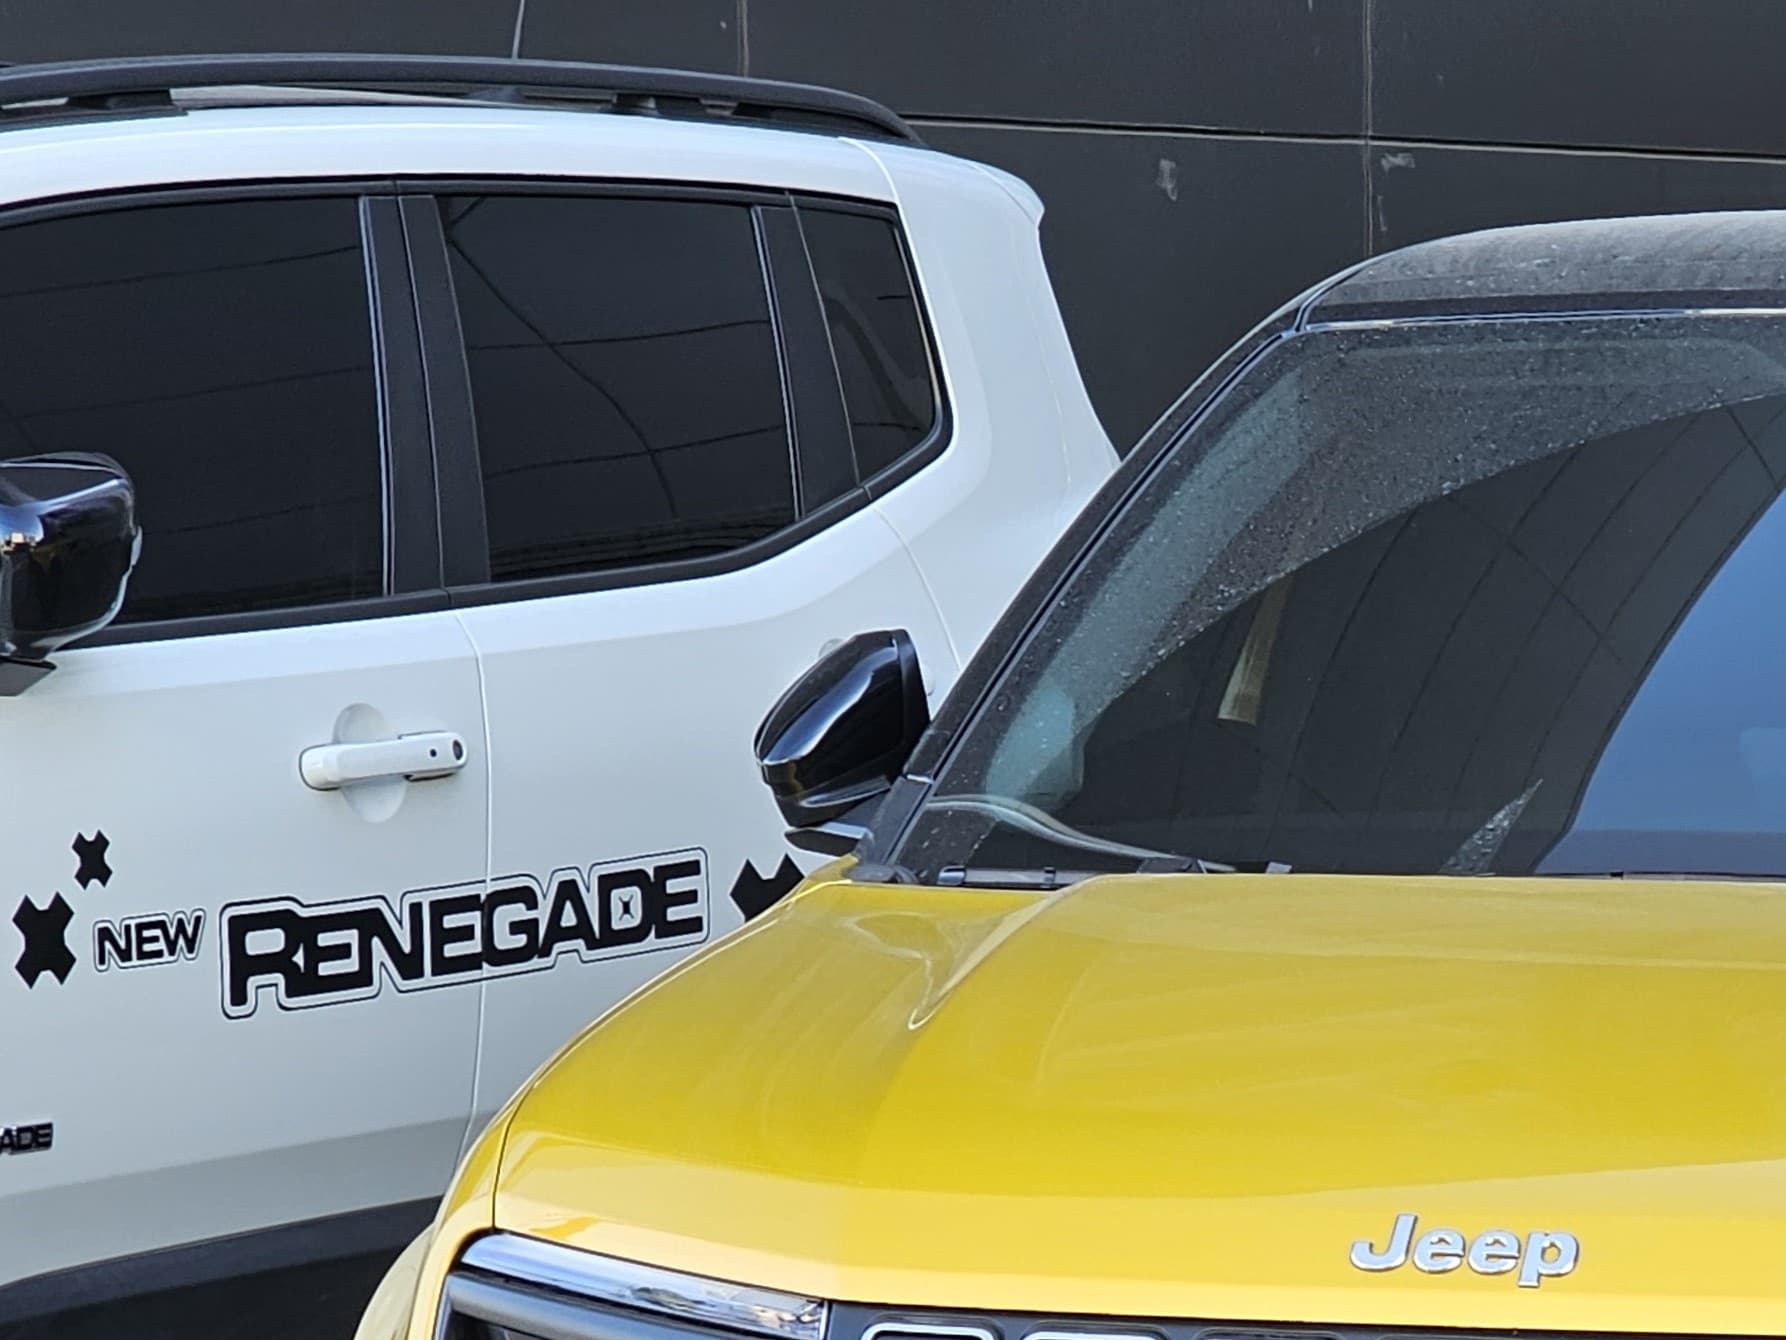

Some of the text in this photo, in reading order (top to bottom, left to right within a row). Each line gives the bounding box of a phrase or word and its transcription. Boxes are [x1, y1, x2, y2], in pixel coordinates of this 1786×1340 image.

[95, 853, 707, 1013] NEW RENEGADE
[1349, 1212, 1580, 1288] Jeep
